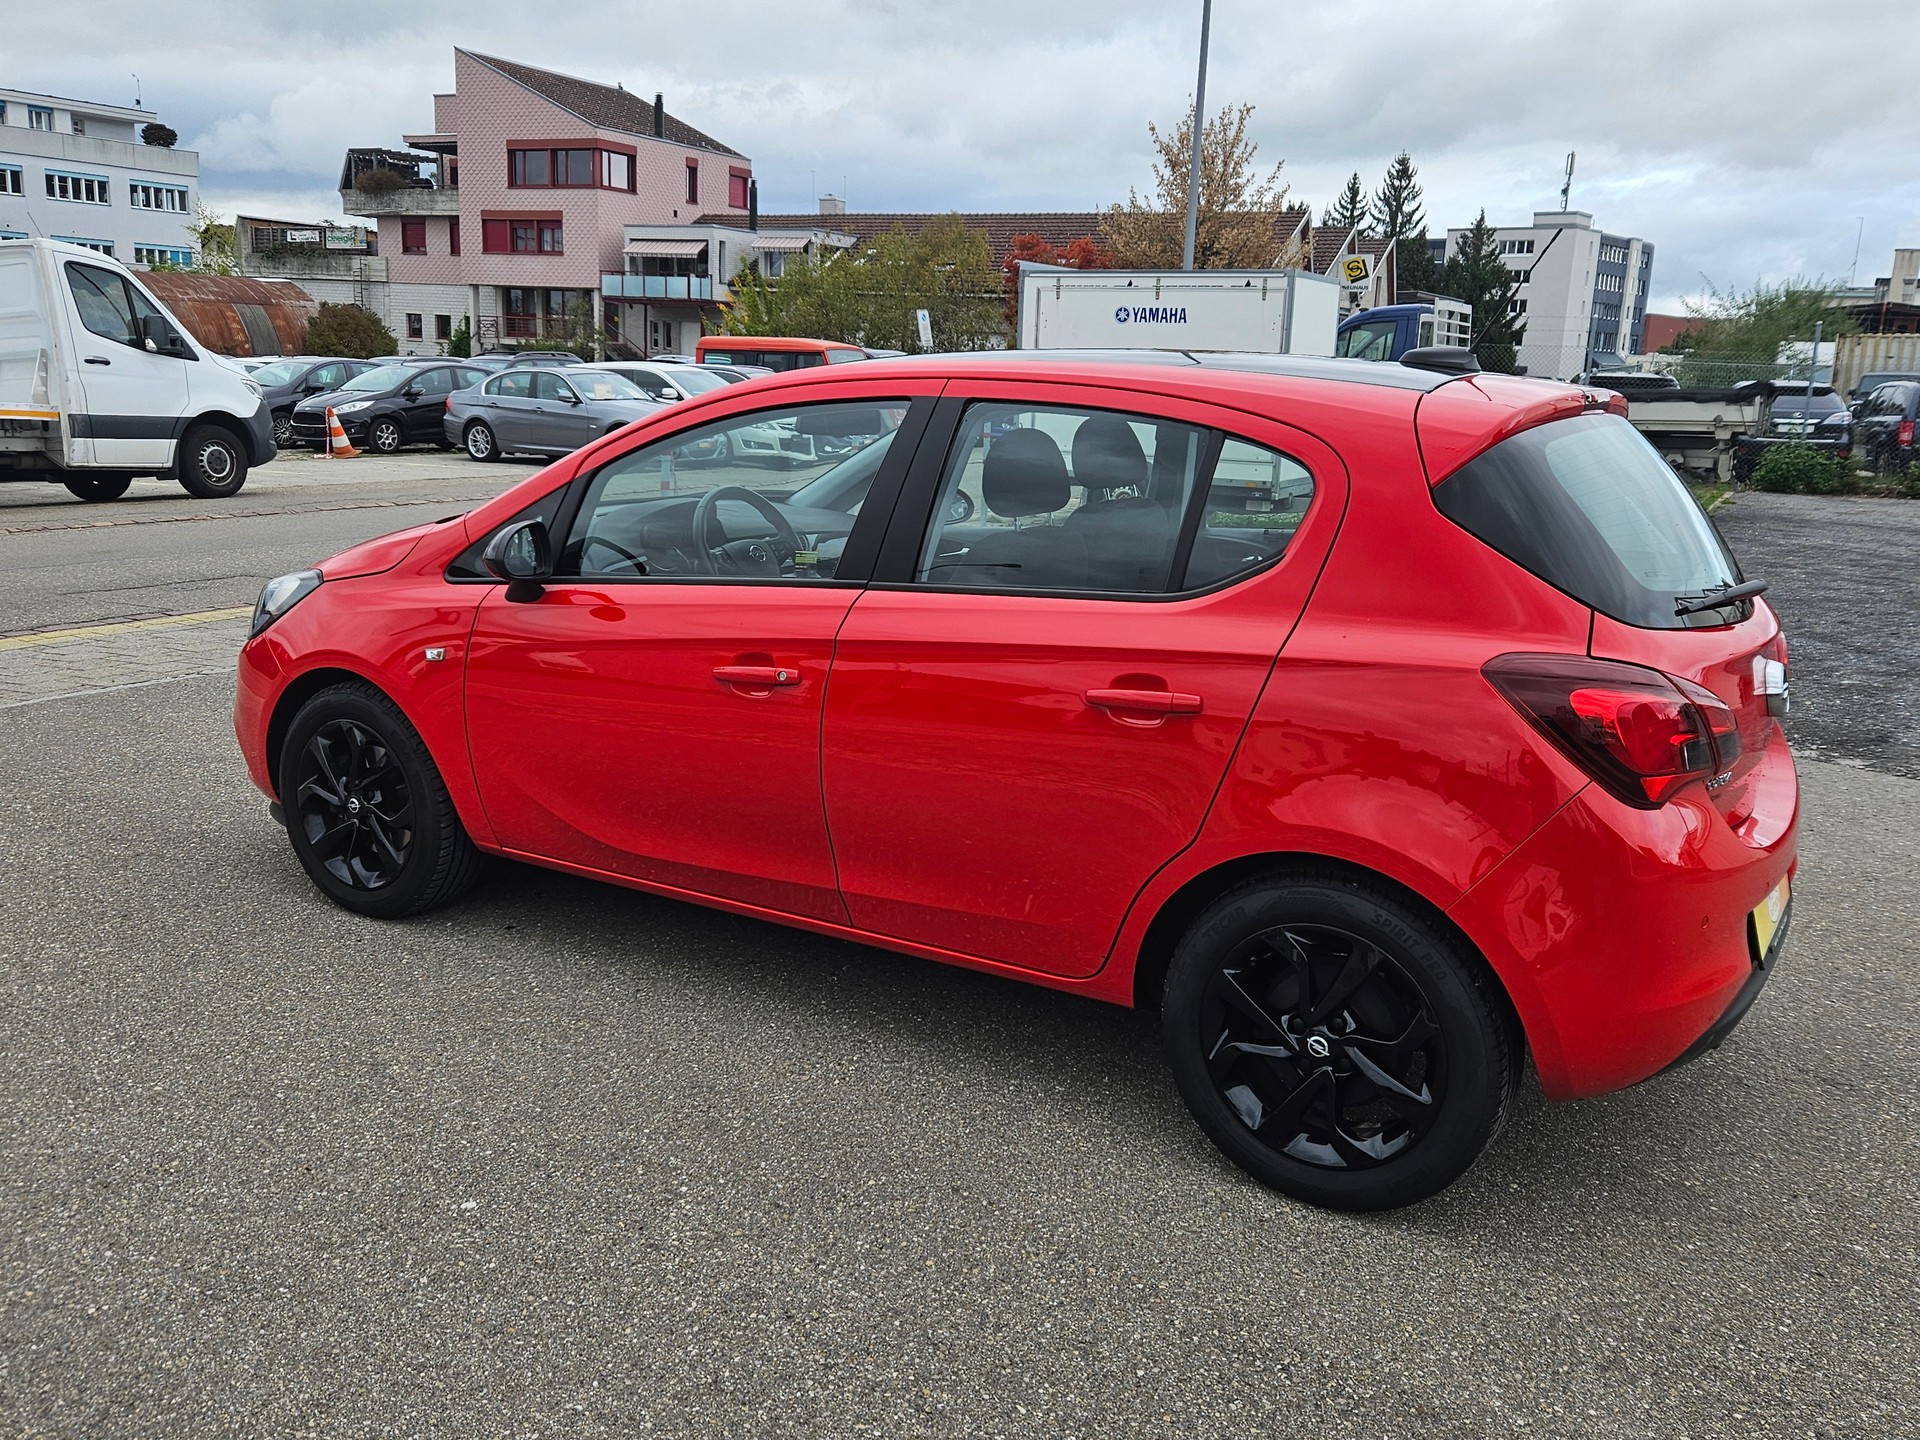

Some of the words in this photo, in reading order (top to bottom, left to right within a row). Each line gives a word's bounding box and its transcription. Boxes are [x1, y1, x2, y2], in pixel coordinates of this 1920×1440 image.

[1132, 307, 1187, 324] YAMAHA
[1371, 912, 1421, 950] SPIRIT
[1420, 951, 1447, 981] PRO
